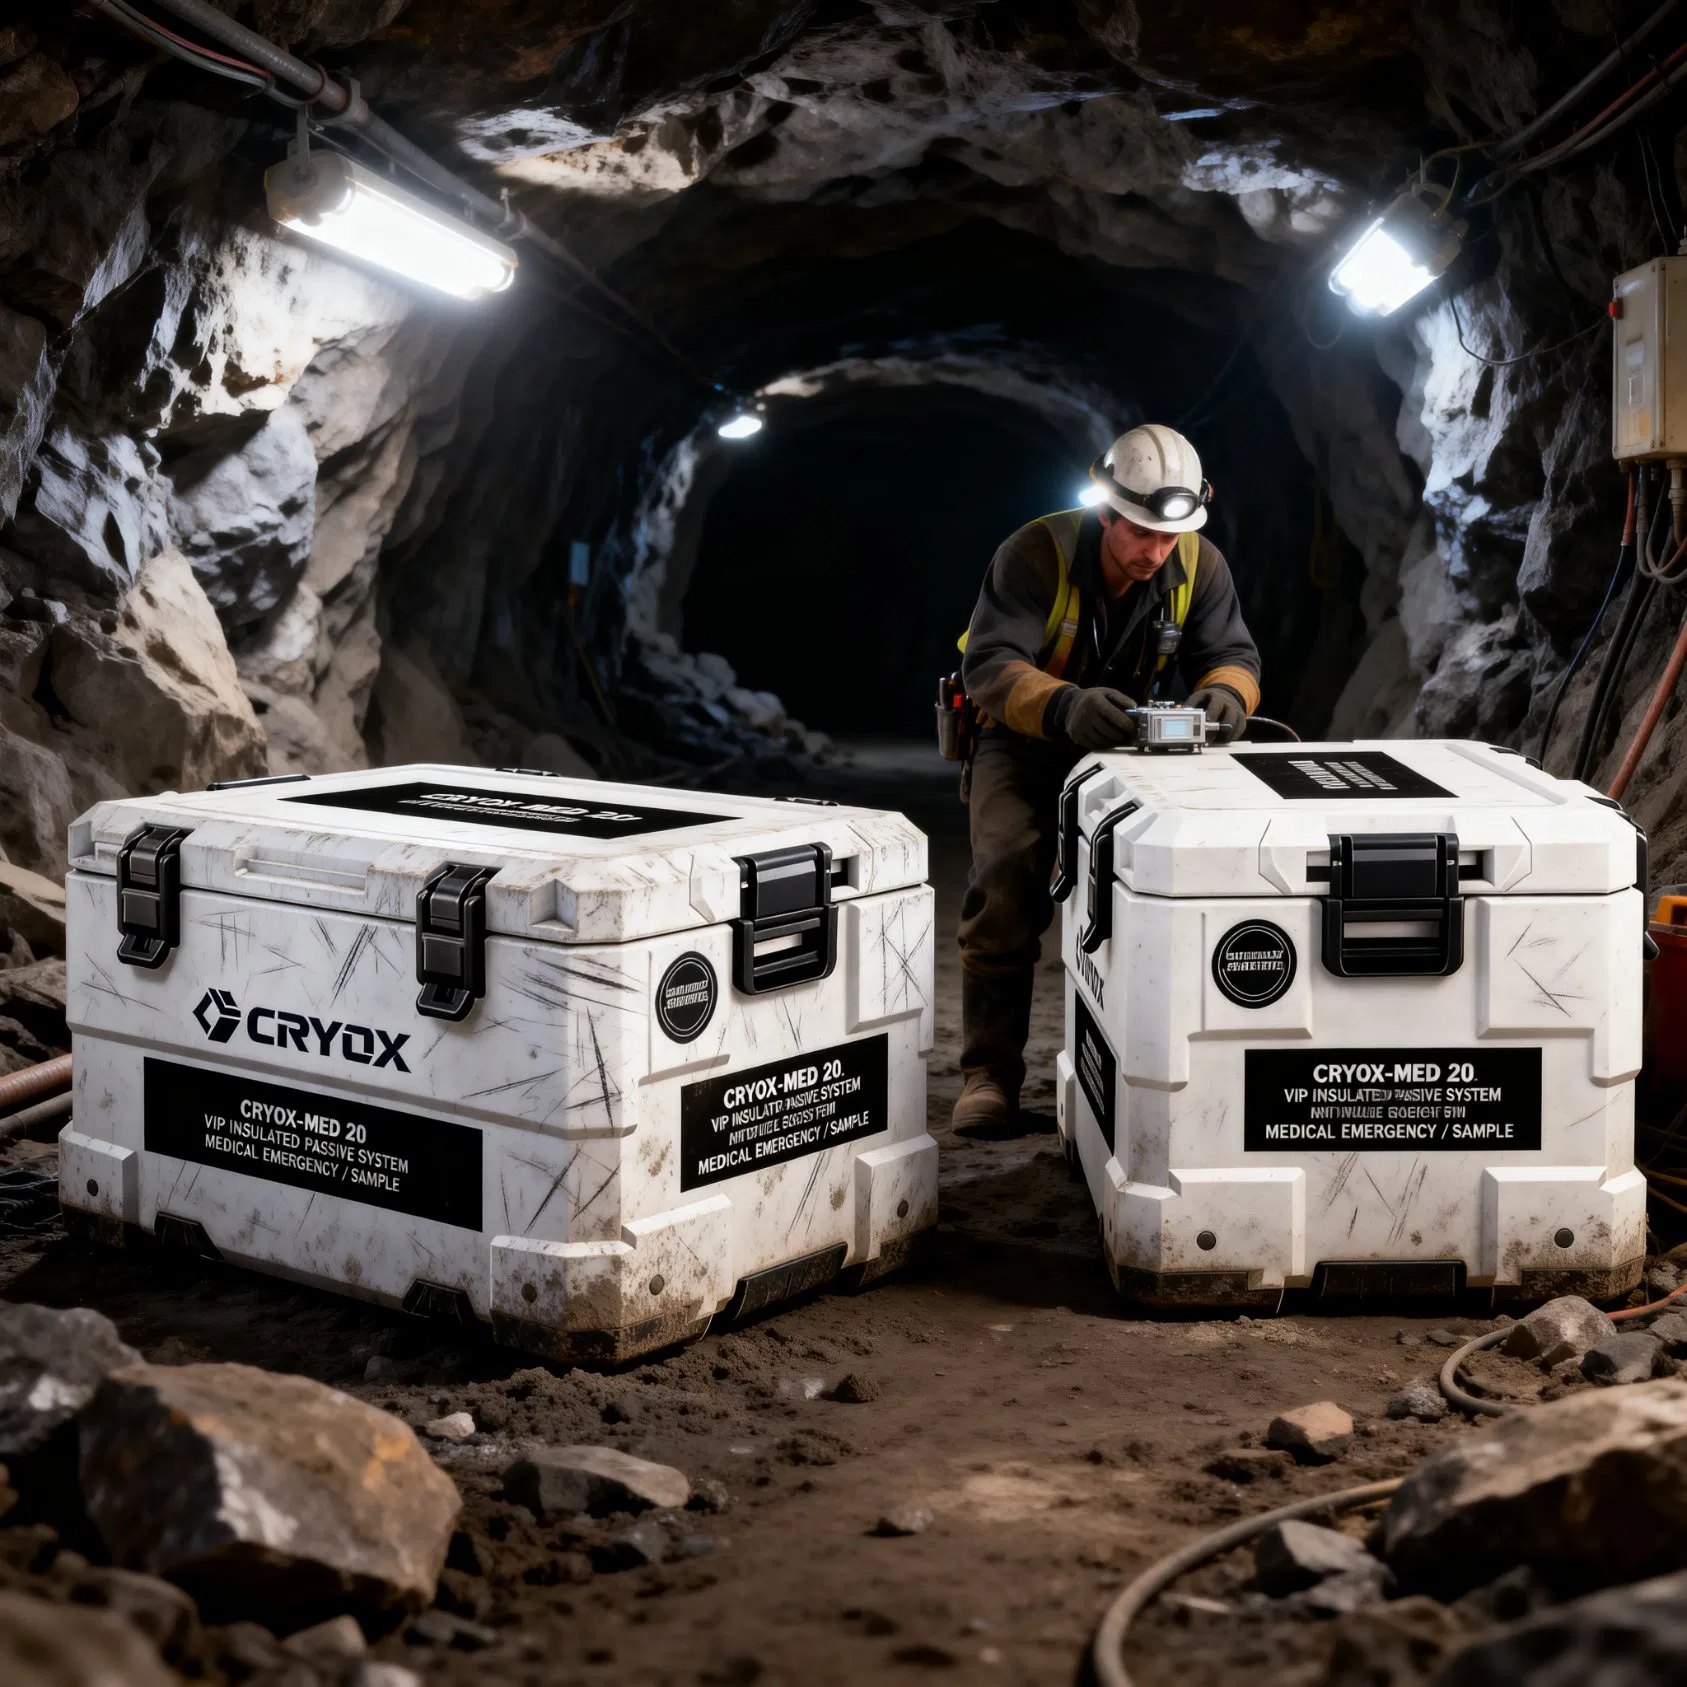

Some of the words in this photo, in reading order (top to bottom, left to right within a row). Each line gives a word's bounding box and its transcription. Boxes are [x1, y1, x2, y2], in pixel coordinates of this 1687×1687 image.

[247, 1006, 411, 1073] CRYOX
[723, 1066, 819, 1109] CRYOX-MED
[1284, 1088, 1309, 1103] VIP
[1446, 1087, 1501, 1102] SYSTEM
[1313, 1063, 1441, 1083] CRYOX-MED
[240, 1100, 341, 1137] CRYOX-MED
[346, 1122, 367, 1144] 20
[711, 1115, 729, 1133] VIP
[820, 1076, 861, 1101] SYSTEM
[204, 1113, 226, 1131] VIP
[229, 1120, 300, 1149] INSULATED
[304, 1137, 355, 1162] PASSIVE
[358, 1151, 409, 1174] SYSTEM
[698, 1150, 752, 1176] MEDICAL
[755, 1127, 821, 1159] EMERGENCY
[830, 1110, 869, 1136] SAMPLE
[1265, 1124, 1336, 1140] MEDICAL
[1341, 1123, 1437, 1139] EMERGENCY
[1441, 1124, 1448, 1140] /
[1452, 1123, 1514, 1139] SAMPLE
[205, 1134, 259, 1160] MEDICAL
[263, 1147, 339, 1179] EMERGENCY
[351, 1168, 400, 1192] SAMPLE
